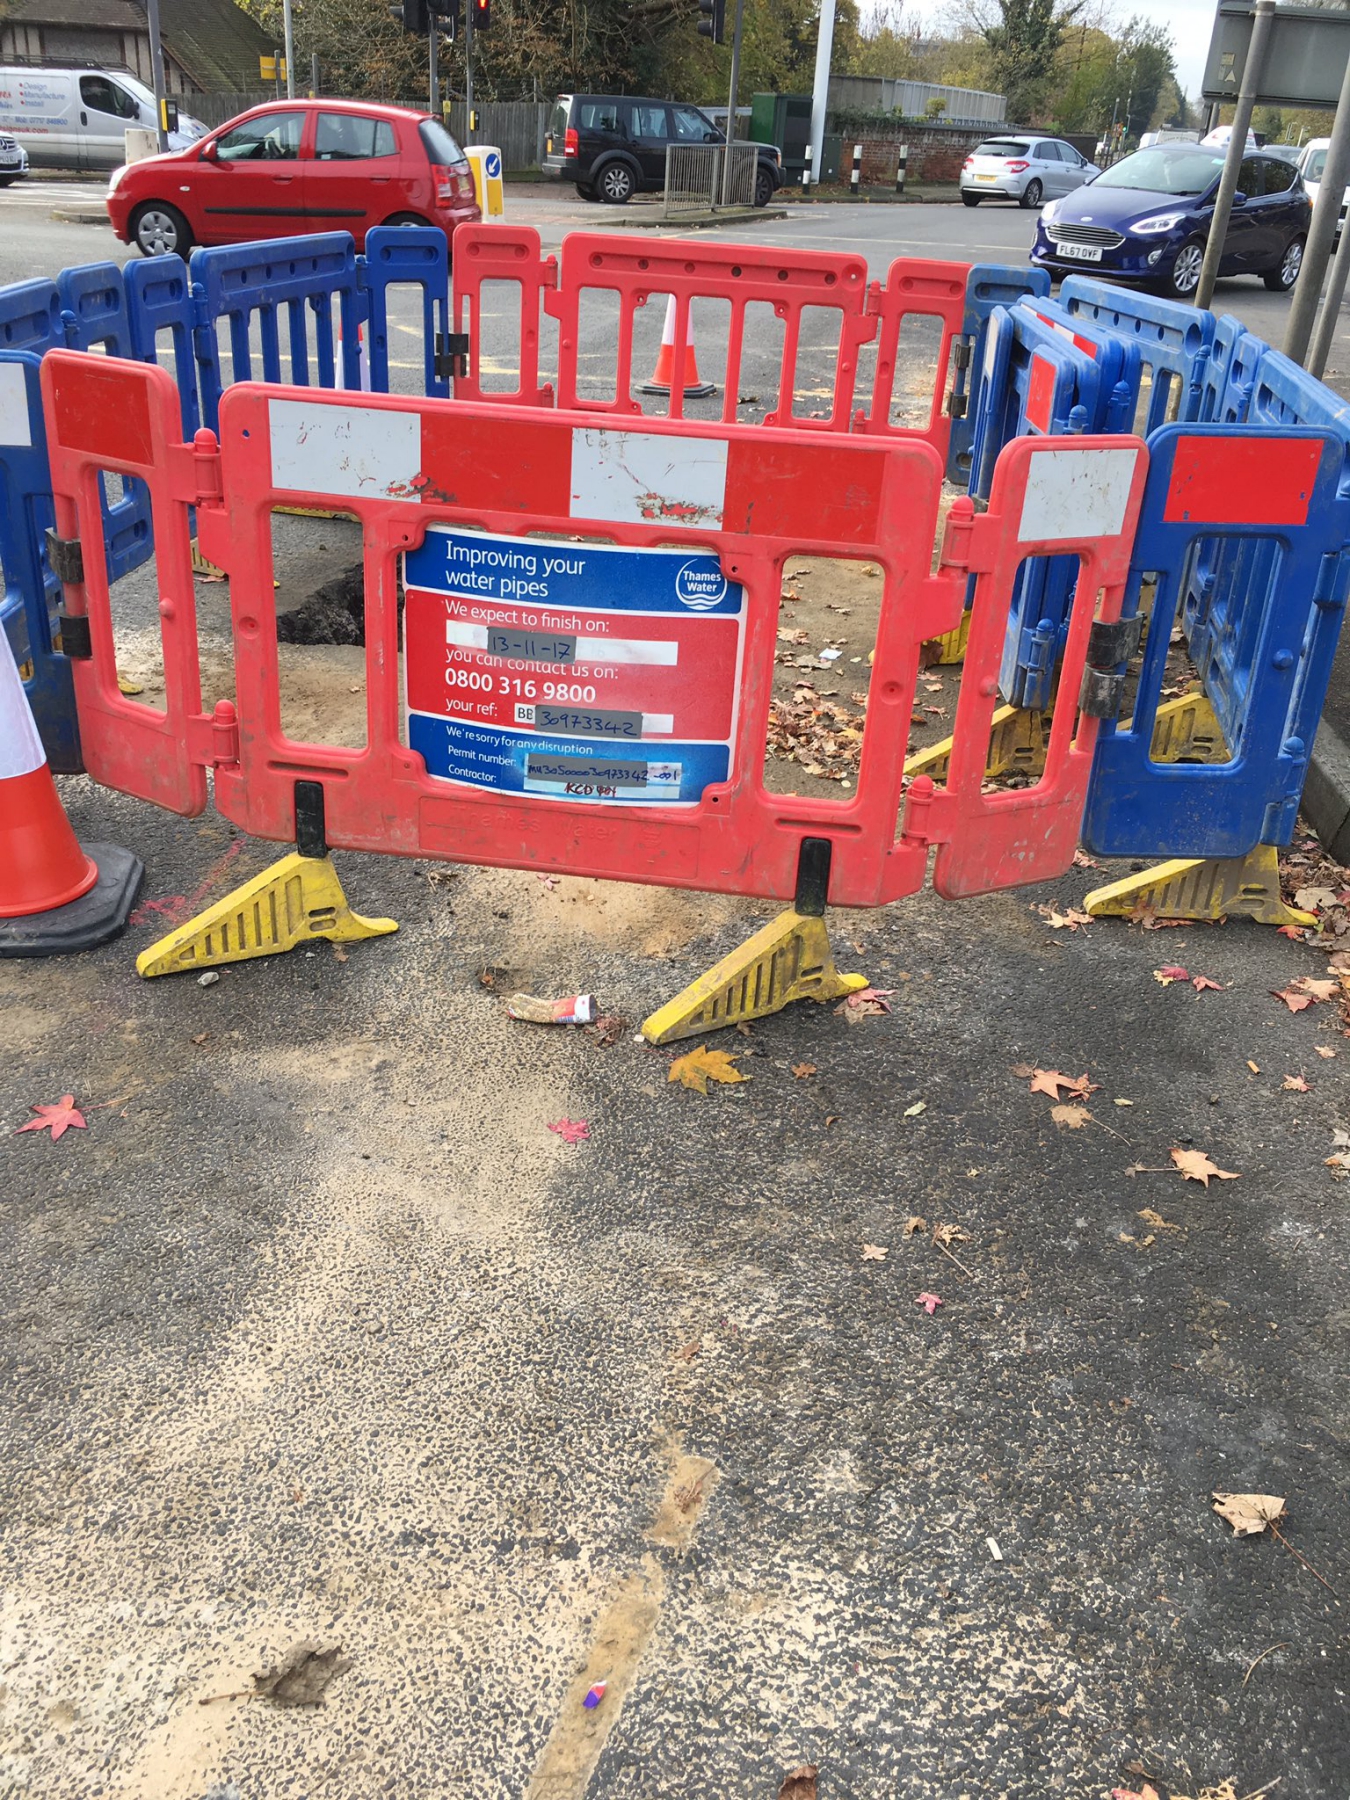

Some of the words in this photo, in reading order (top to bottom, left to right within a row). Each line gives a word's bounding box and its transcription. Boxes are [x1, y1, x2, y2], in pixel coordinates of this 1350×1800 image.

[24, 82, 48, 91] Design
[24, 91, 66, 100] Manufacture
[1060, 245, 1080, 257] FL67
[446, 540, 537, 576] Improving
[542, 558, 586, 578] your
[445, 570, 495, 591] water
[500, 576, 549, 599] pipes
[683, 570, 721, 582] Thames
[686, 582, 717, 593] Water
[444, 599, 468, 617] We
[471, 606, 518, 625] expect
[522, 613, 538, 627] to
[541, 612, 582, 631] finish
[585, 620, 610, 633] on:
[493, 636, 571, 660] 13-11-17
[445, 649, 473, 664] you
[476, 654, 503, 668] can
[507, 657, 567, 676] contact
[571, 665, 589, 678] us
[593, 666, 619, 679] on:
[445, 667, 493, 692] 0800
[498, 677, 537, 698] 316
[542, 682, 597, 703] 9800
[445, 698, 475, 713] your
[476, 702, 498, 717] ref:
[540, 711, 637, 736] 30973342
[446, 725, 474, 741] We're
[474, 732, 501, 748] sorry
[501, 736, 517, 748] for
[517, 739, 537, 752] any
[537, 738, 593, 756] disruption
[448, 745, 477, 761] Permit
[478, 752, 517, 767] number:
[448, 764, 497, 783] Contractor:
